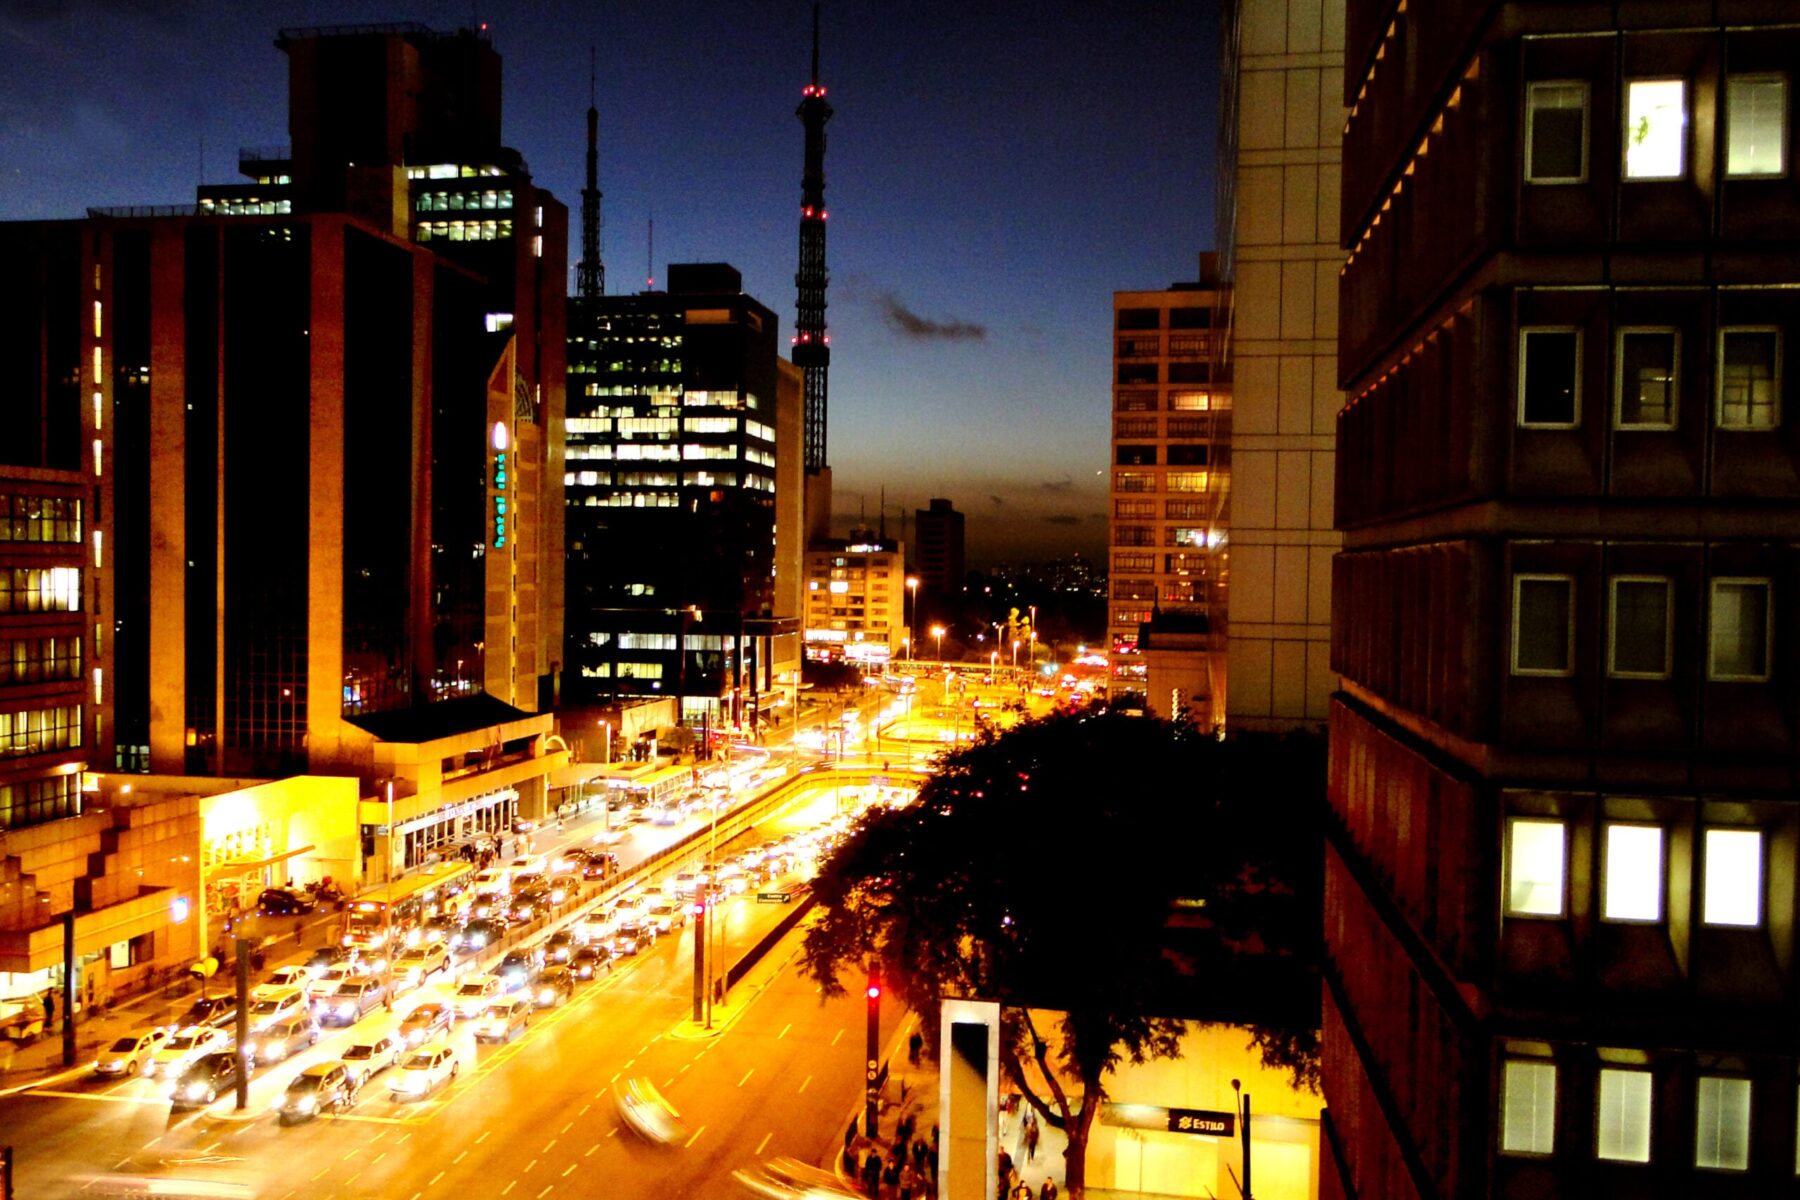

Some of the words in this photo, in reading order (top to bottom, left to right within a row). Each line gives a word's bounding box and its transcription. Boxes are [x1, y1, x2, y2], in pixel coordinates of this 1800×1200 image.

[495, 453, 506, 489] ibis
[495, 496, 506, 548] hotel
[1193, 1118, 1225, 1131] ESTILO
